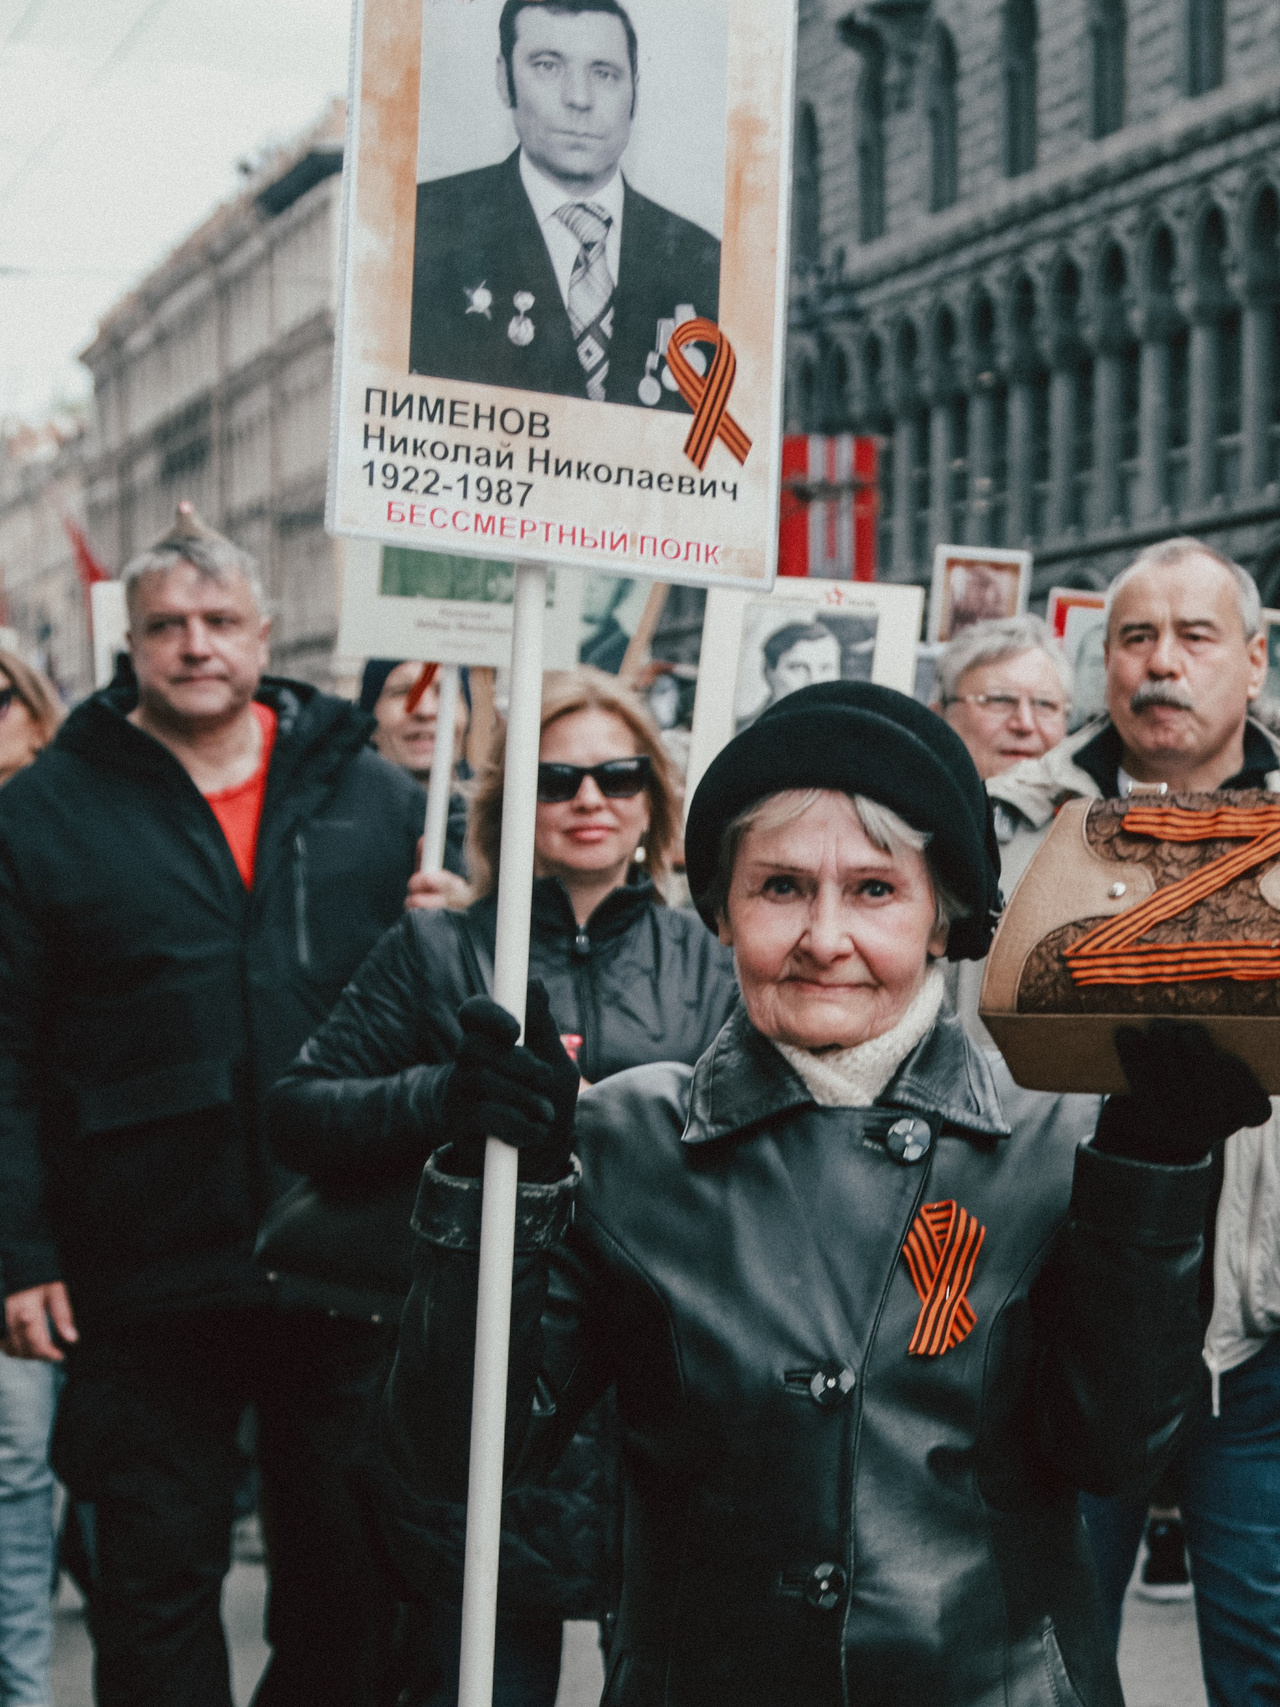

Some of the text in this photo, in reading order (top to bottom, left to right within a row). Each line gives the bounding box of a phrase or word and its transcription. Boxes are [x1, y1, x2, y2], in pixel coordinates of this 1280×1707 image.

[363, 387, 551, 438] ПИМЕНОВ
[362, 423, 739, 502] Николай Николаевич
[362, 460, 535, 508] 1922-1987
[386, 501, 722, 567] БЕССМЕРТНЫЙ ПОЛК
